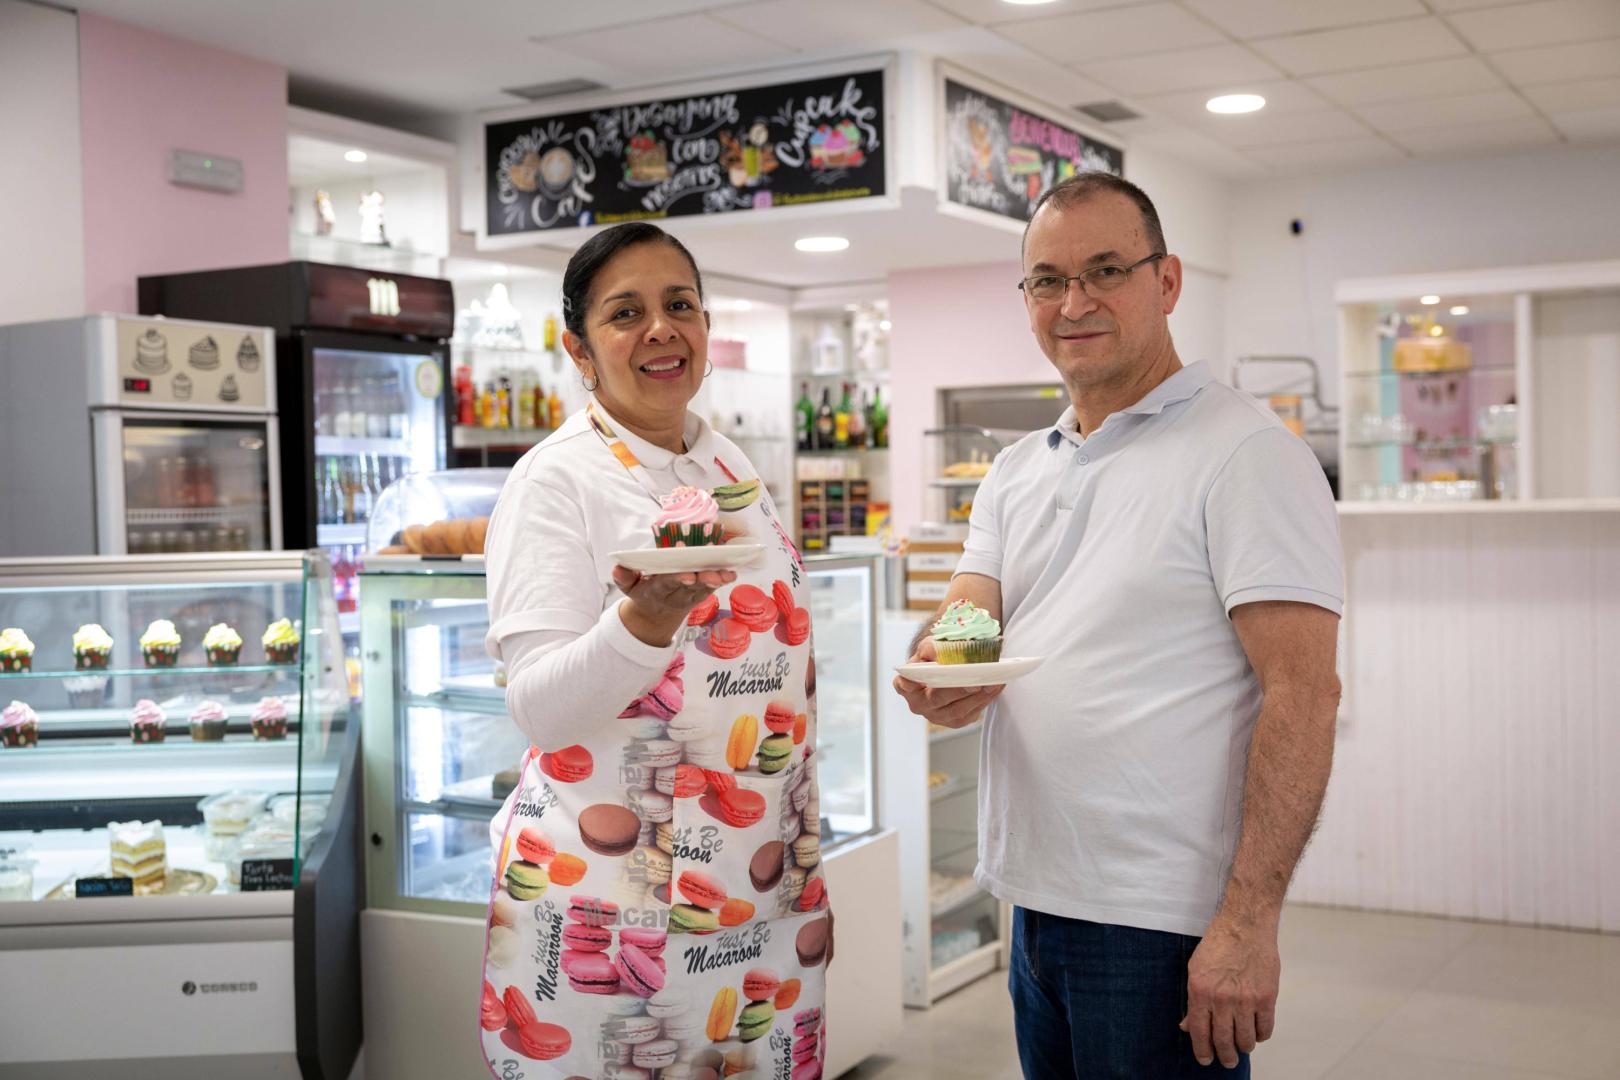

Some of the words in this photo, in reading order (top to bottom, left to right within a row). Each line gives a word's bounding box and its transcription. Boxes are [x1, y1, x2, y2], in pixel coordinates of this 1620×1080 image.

[740, 657, 771, 681] just
[775, 651, 791, 677] Be
[700, 825, 724, 853] Be
[673, 844, 712, 864] roon
[534, 900, 555, 923] Be
[717, 930, 749, 954] just
[752, 921, 771, 944] Be
[536, 913, 564, 1001] Macaroon
[684, 944, 762, 974] Macaroon
[769, 1027, 784, 1051] Be
